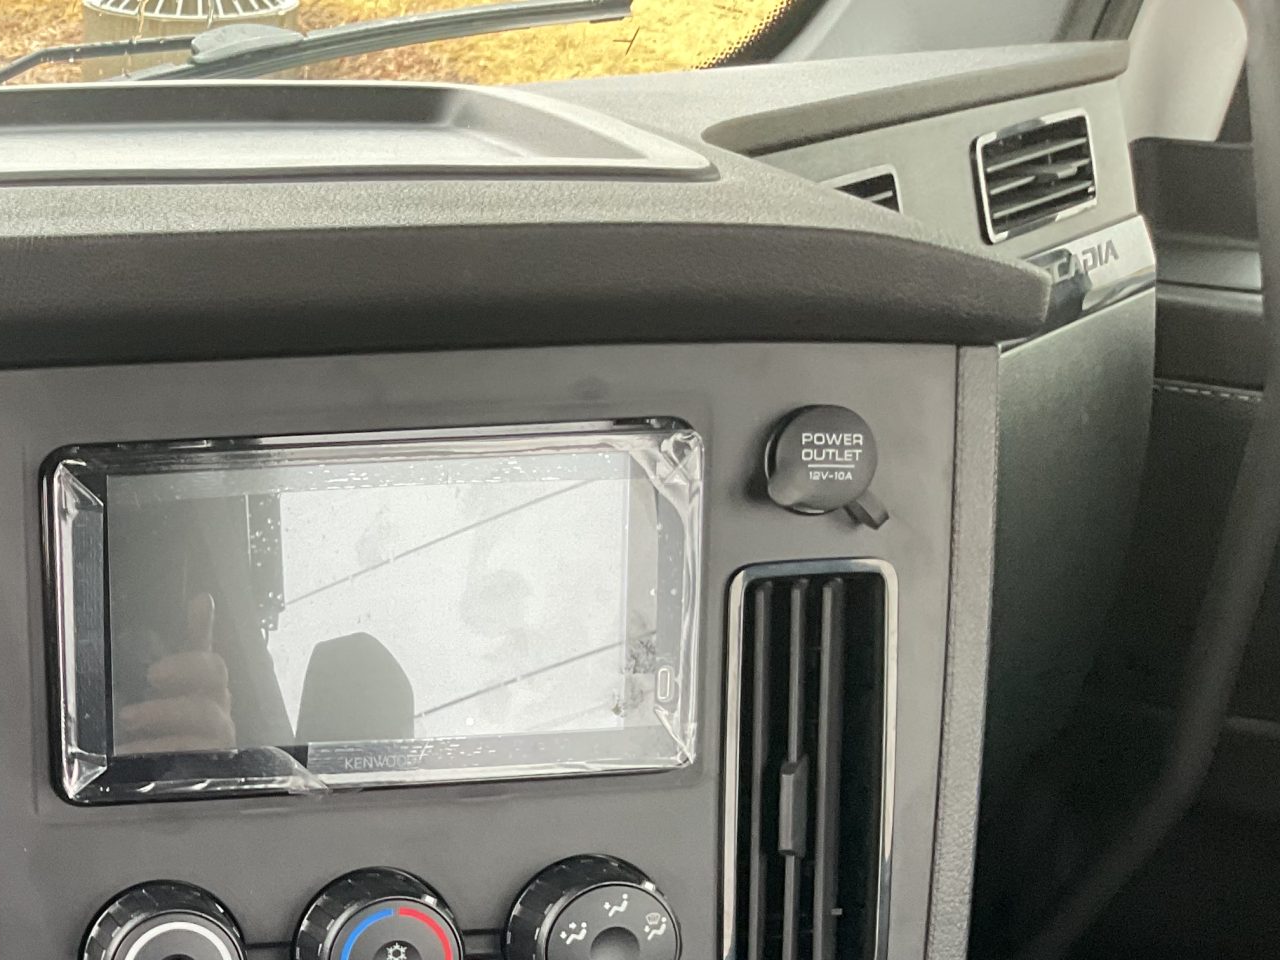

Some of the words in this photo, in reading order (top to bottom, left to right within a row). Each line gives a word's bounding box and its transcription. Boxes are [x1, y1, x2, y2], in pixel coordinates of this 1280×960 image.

[801, 432, 863, 446] POWER
[801, 448, 863, 461] OUTLET
[808, 471, 853, 481] 12V-10A
